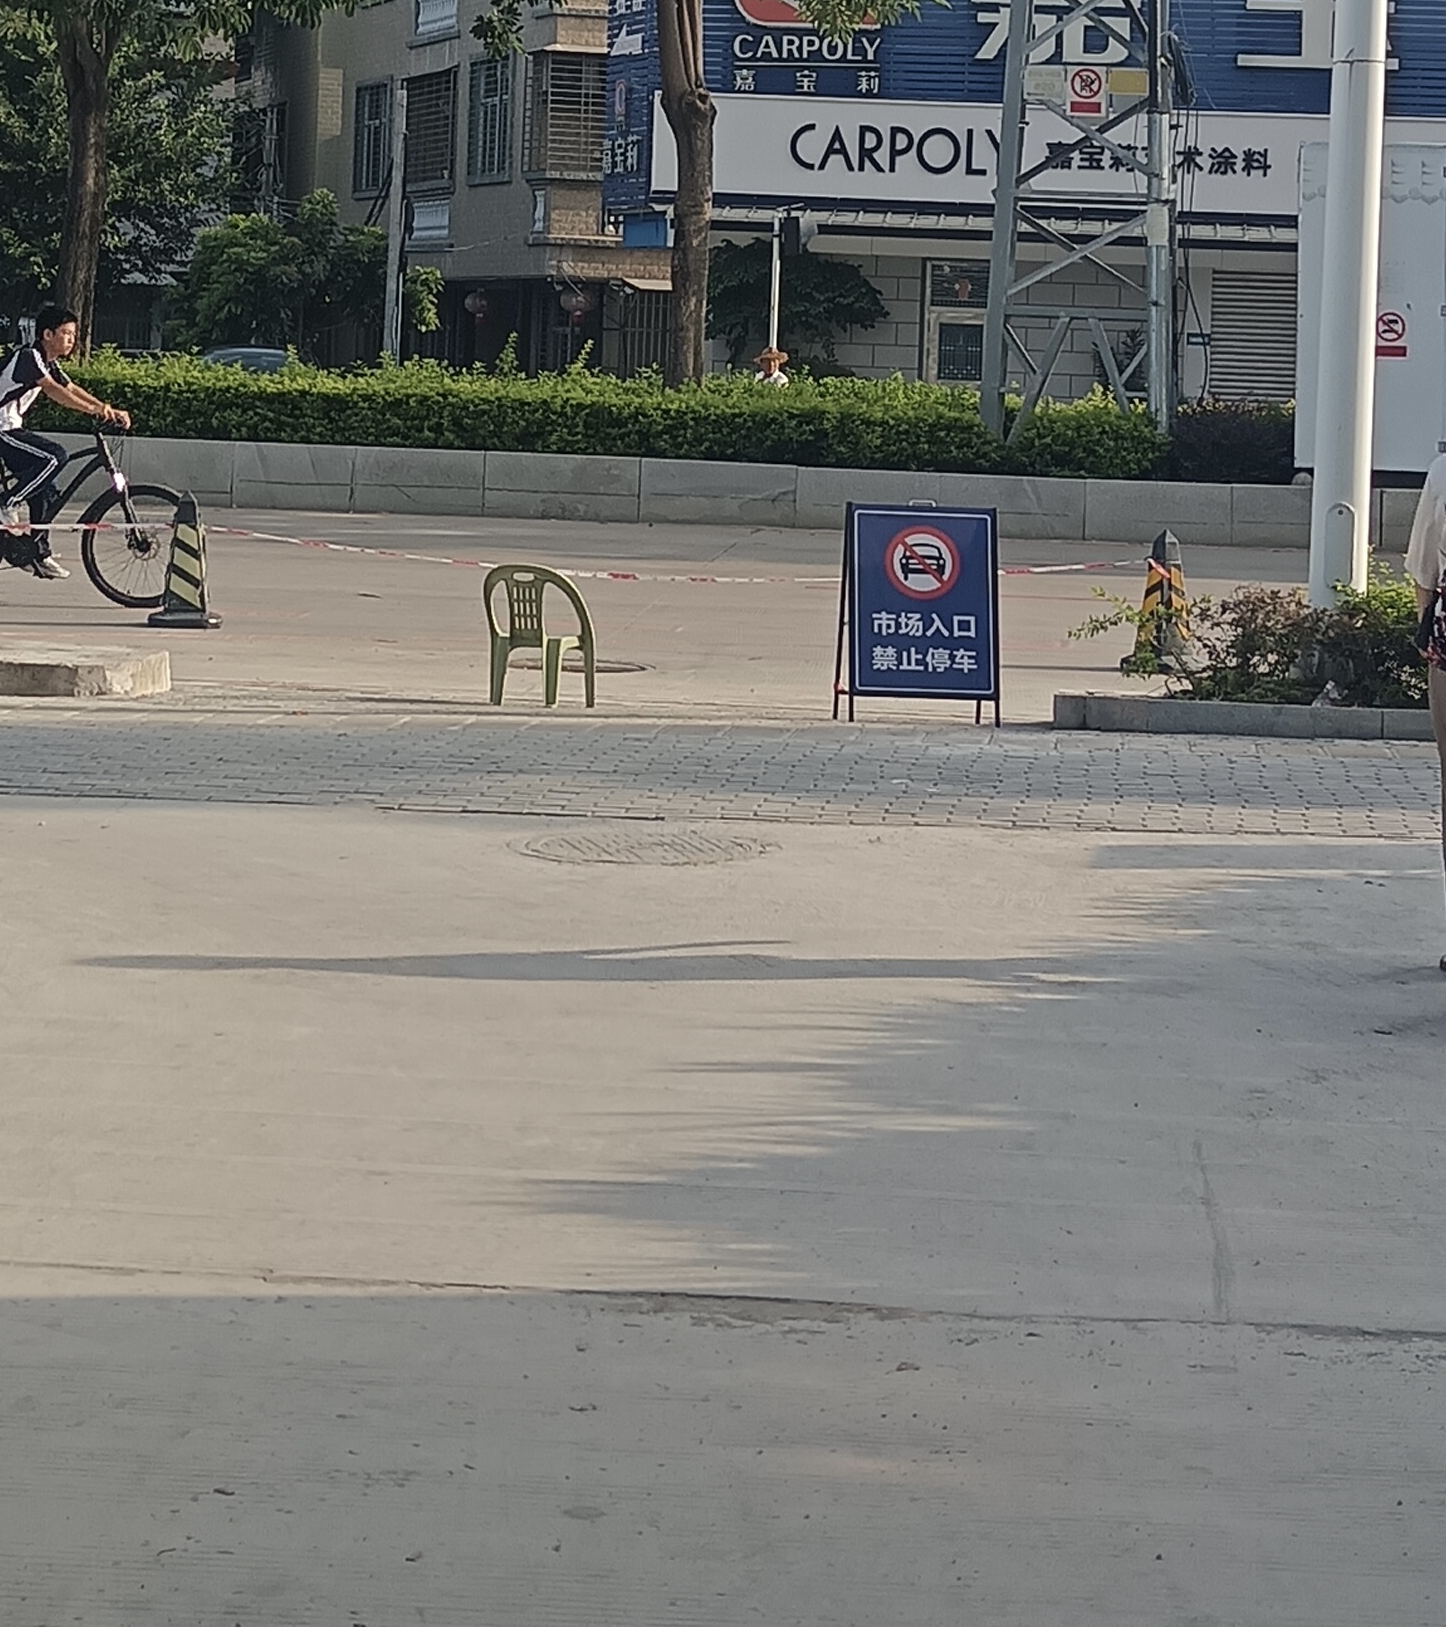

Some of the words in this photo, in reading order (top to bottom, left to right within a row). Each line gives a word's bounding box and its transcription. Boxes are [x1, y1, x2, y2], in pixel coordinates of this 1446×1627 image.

[733, 34, 882, 61] CARPOLY
[733, 69, 880, 94] 嘉宝莉
[871, 611, 976, 639] 市场入口
[871, 645, 978, 673] 禁止停车
